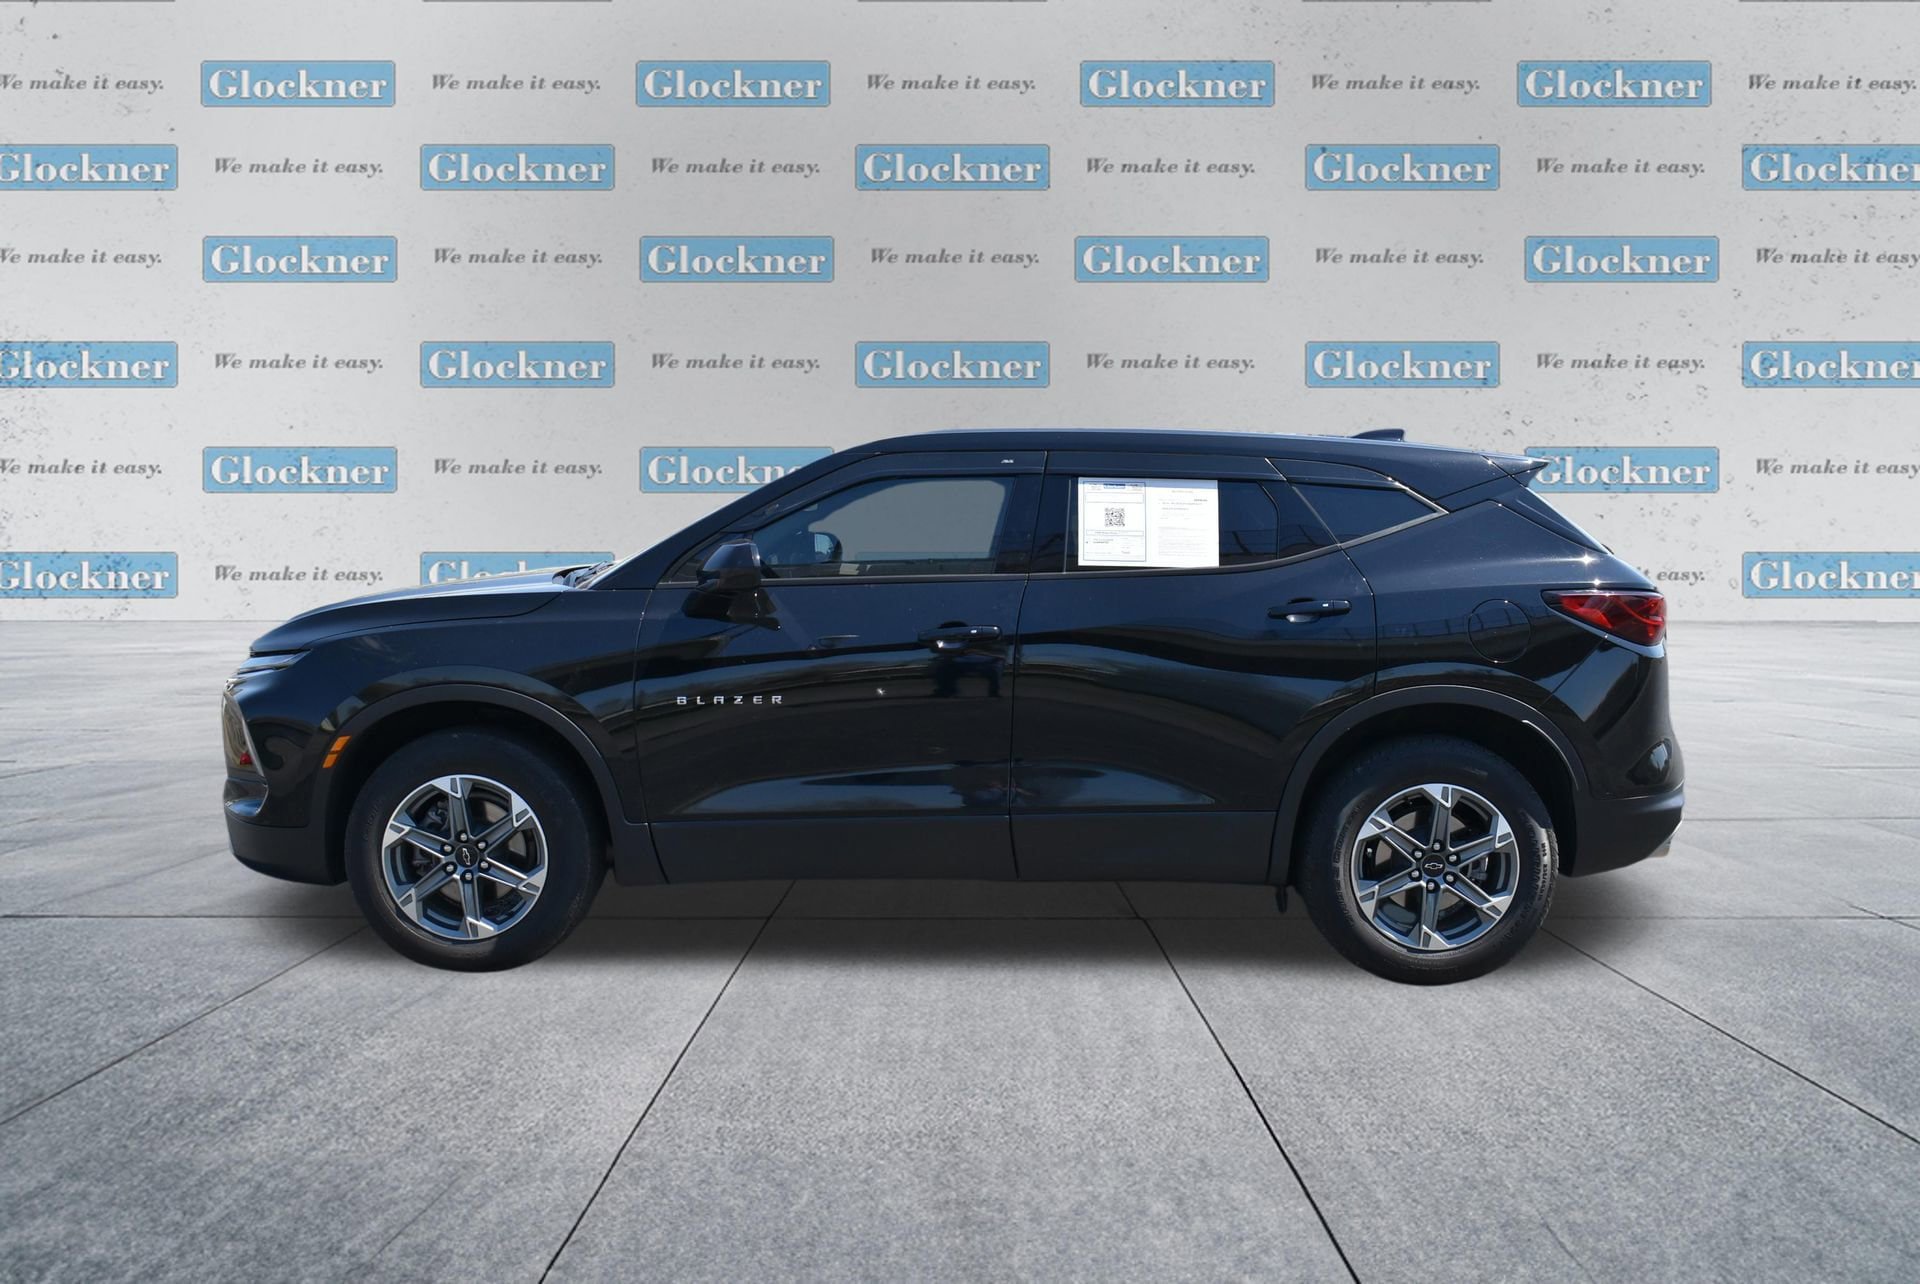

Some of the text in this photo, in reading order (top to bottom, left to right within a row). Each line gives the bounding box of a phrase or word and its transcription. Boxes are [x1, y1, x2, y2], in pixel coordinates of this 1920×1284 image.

[0, 73, 164, 94] We make it easy.
[208, 69, 388, 99] Glockner
[432, 73, 601, 94] We make it easy.
[644, 69, 822, 99] Glockner
[868, 73, 1036, 94] We make it easy.
[1088, 69, 1266, 99] Glockner
[1312, 73, 1480, 94] We make it easy.
[1524, 69, 1704, 99] Glockner
[1748, 73, 1917, 94] We make it easy.
[0, 153, 170, 183] Glockner
[214, 157, 383, 178] We make it easy.
[428, 153, 606, 183] Glockner
[652, 157, 820, 178] We make it easy.
[862, 153, 1042, 183] Glockner
[1086, 157, 1255, 178] We make it easy.
[1312, 153, 1492, 183] Glockner
[1536, 157, 1705, 178] We make it easy.
[0, 247, 162, 268] We make it easy.
[210, 244, 390, 274] Glockner
[434, 247, 602, 268] We make it easy.
[648, 245, 826, 275] Glockner
[870, 247, 1039, 268] We make it easy.
[1082, 245, 1262, 275] Glockner
[1316, 247, 1484, 268] We make it easy.
[1532, 244, 1712, 274] Glockner
[1756, 247, 1783, 264] We
[1790, 247, 1848, 264] make
[1853, 248, 1870, 264] it
[0, 350, 170, 380] Glockner
[214, 353, 383, 374] We make it easy.
[428, 350, 606, 380] Glockner
[652, 353, 820, 374] We make it easy.
[862, 350, 1042, 380] Glockner
[1086, 353, 1255, 374] We make it easy.
[1312, 350, 1492, 380] Glockner
[1536, 353, 1705, 374] We make it easy.
[0, 458, 162, 480] We make it easy.
[210, 455, 390, 485] Glockner
[434, 458, 602, 480] We make it easy.
[648, 455, 801, 485] Glockn
[1756, 458, 1783, 474] We
[1790, 458, 1848, 474] make
[1853, 459, 1870, 474] it
[0, 560, 170, 590] Glockner
[214, 565, 383, 586] We make it easy.
[1656, 570, 1704, 586] easy.
[676, 695, 783, 705] BLAZER
